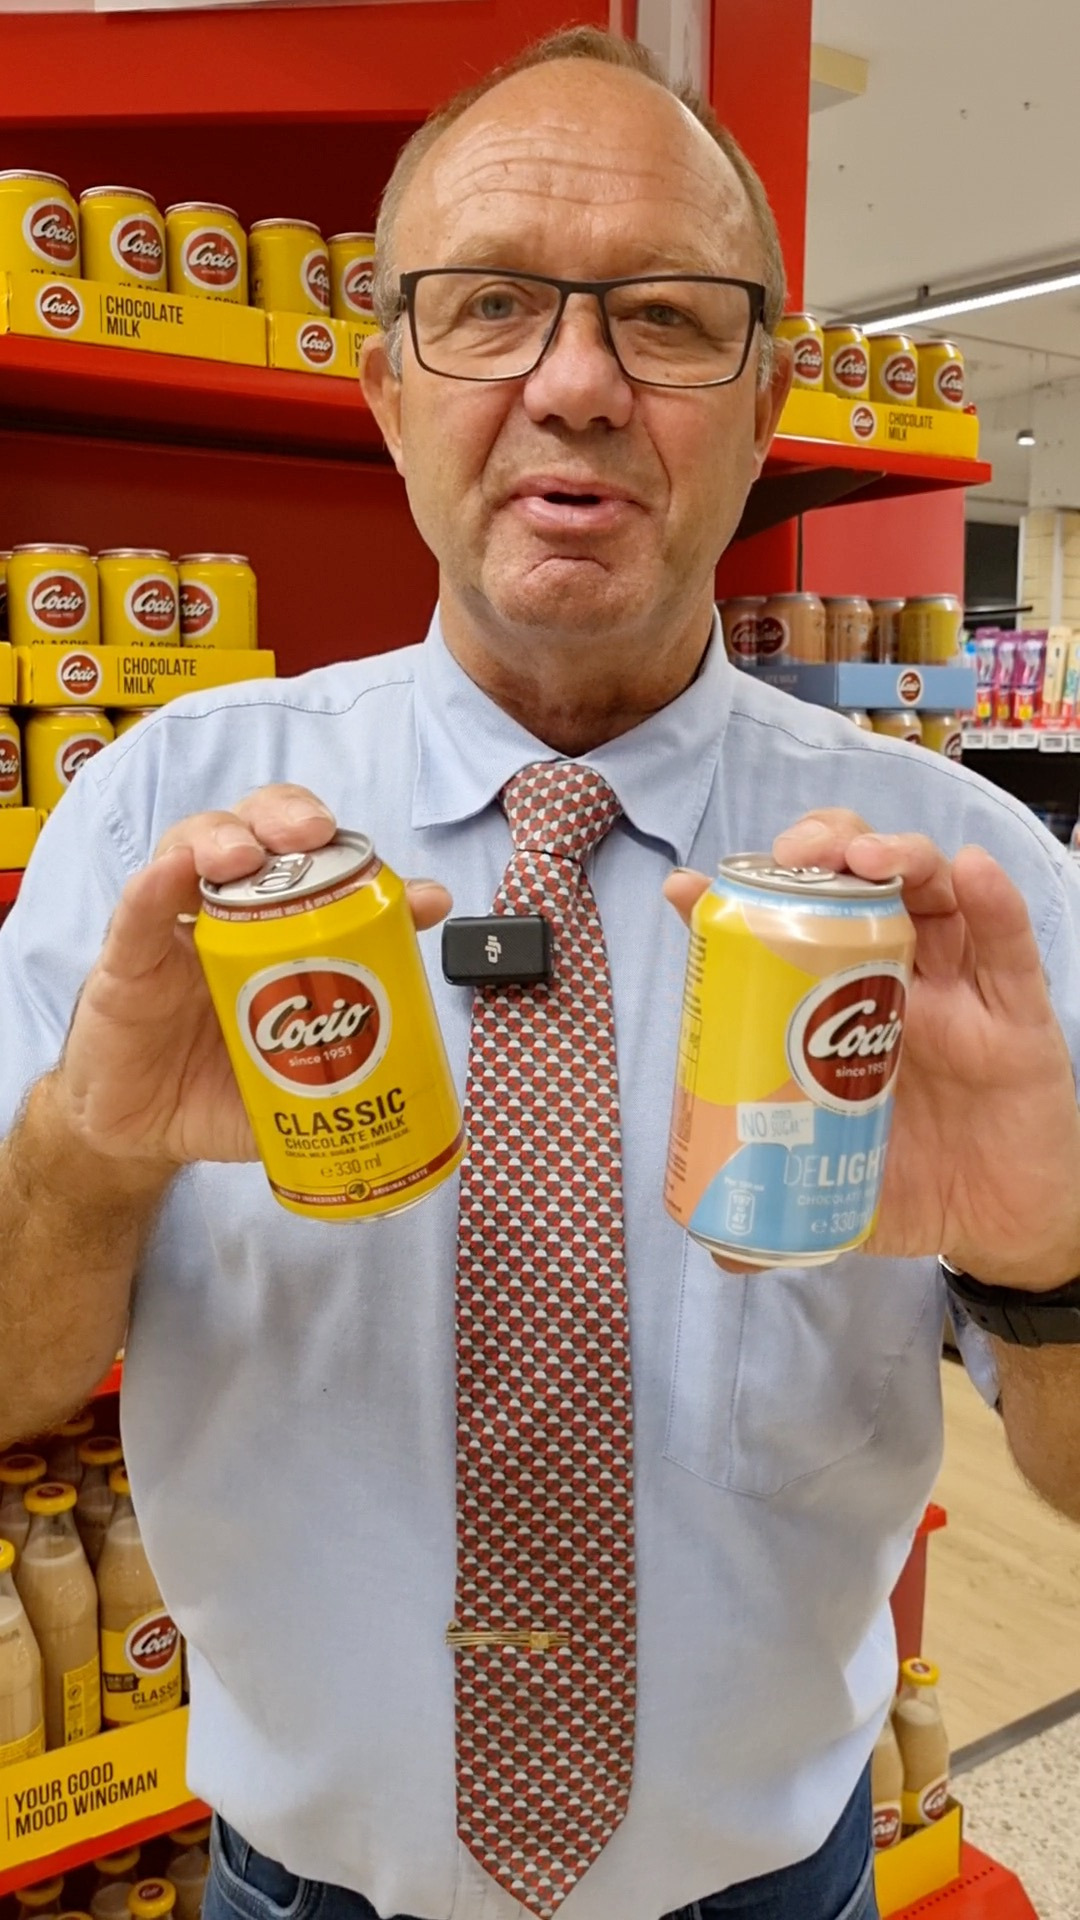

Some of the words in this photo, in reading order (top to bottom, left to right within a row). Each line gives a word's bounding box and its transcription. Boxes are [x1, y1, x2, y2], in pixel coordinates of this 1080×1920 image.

[33, 214, 76, 243] Cocio
[119, 229, 162, 258] Cocio
[188, 241, 237, 272] Cocio
[42, 293, 78, 316] Cocio
[106, 295, 184, 325] CHOCOLATE
[107, 316, 141, 339] MILK
[301, 331, 332, 352] Cocio
[836, 356, 867, 376] Cocio
[886, 363, 917, 383] Cocio
[888, 412, 933, 430] CHOCOLATE
[888, 426, 906, 441] MILK
[34, 584, 84, 611] Cocio
[133, 588, 174, 614] Cocio
[62, 662, 97, 683] Cocio
[123, 657, 198, 676] CHOCOLATE
[123, 675, 156, 695] MILK
[256, 995, 372, 1052] Cocio
[807, 999, 903, 1058] Cocio
[289, 1055, 321, 1067] since
[323, 1045, 353, 1061] 1951
[835, 1065, 866, 1078] since
[274, 1087, 406, 1136] CLASSIC
[285, 1130, 367, 1151] CHOCOLATE
[371, 1114, 406, 1139] MILK
[742, 1111, 768, 1137] NO
[334, 1158, 362, 1177] 330
[365, 1153, 382, 1171] ml
[830, 1210, 857, 1234] 330
[14, 1780, 62, 1814] YOUR
[67, 1762, 113, 1795] GOOD
[15, 1801, 68, 1838] MOOD
[73, 1768, 158, 1816] WINGMAN
